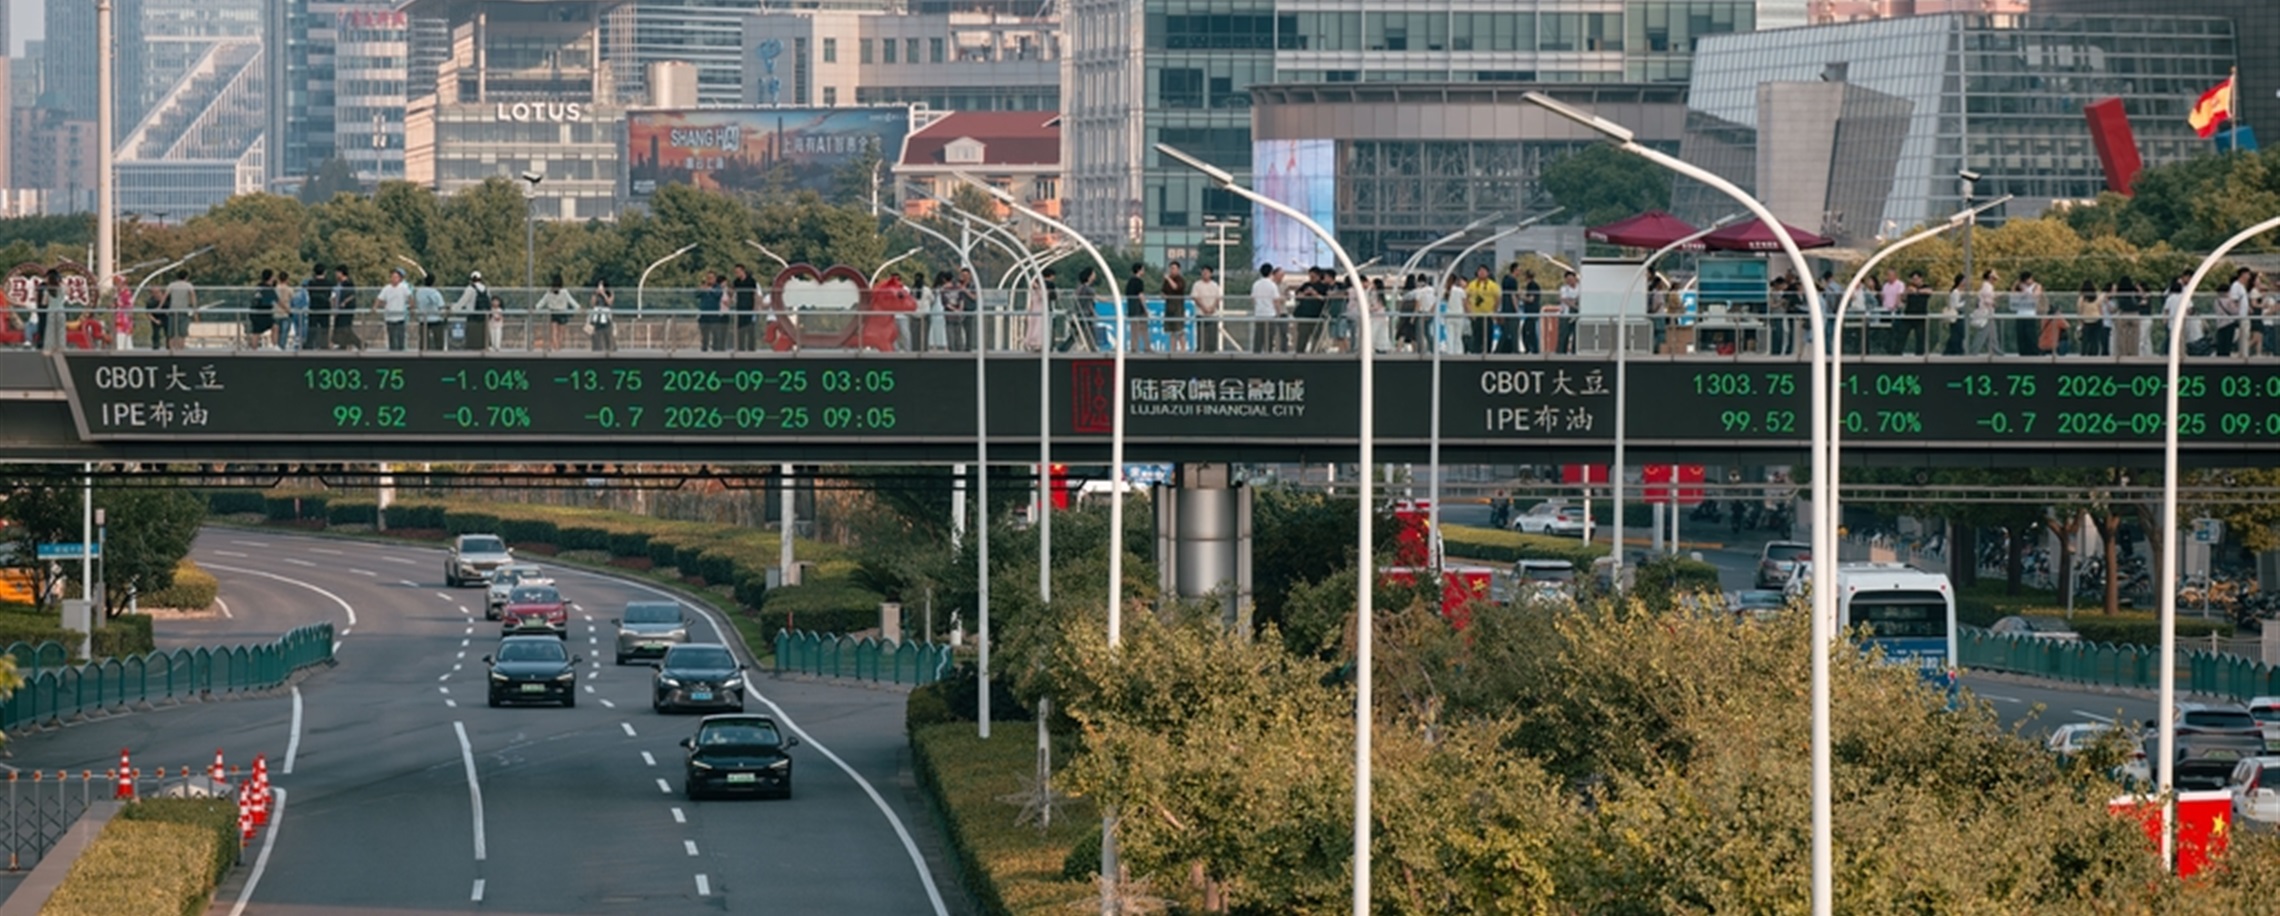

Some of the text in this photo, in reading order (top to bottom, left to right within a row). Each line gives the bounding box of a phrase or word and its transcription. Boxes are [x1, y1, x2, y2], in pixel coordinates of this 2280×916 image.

[498, 102, 580, 121] LOTUS
[11, 278, 88, 303] 马钱
[95, 364, 896, 393] CBOT大豆 1303.75 -1.04% -13.75 2026-09-25 03:05
[1130, 378, 1305, 402] 陆家嘴金融城
[1480, 368, 1610, 395] CBOT大豆
[1694, 373, 1796, 396] 1303.75
[1946, 374, 2037, 397] -13.75
[2057, 375, 2207, 397] 2026-09-25
[102, 401, 896, 430] IPE布油 99.52 -0.70% -0.7 2026-09-25 09:05
[1130, 404, 1305, 417] LUJIAZUI FINANCIAL CITY
[1486, 404, 1594, 432] IPE布油
[1721, 410, 1796, 433] 99.52
[1977, 411, 2037, 433] -0.7
[2056, 412, 2208, 435] 2026-09-25
